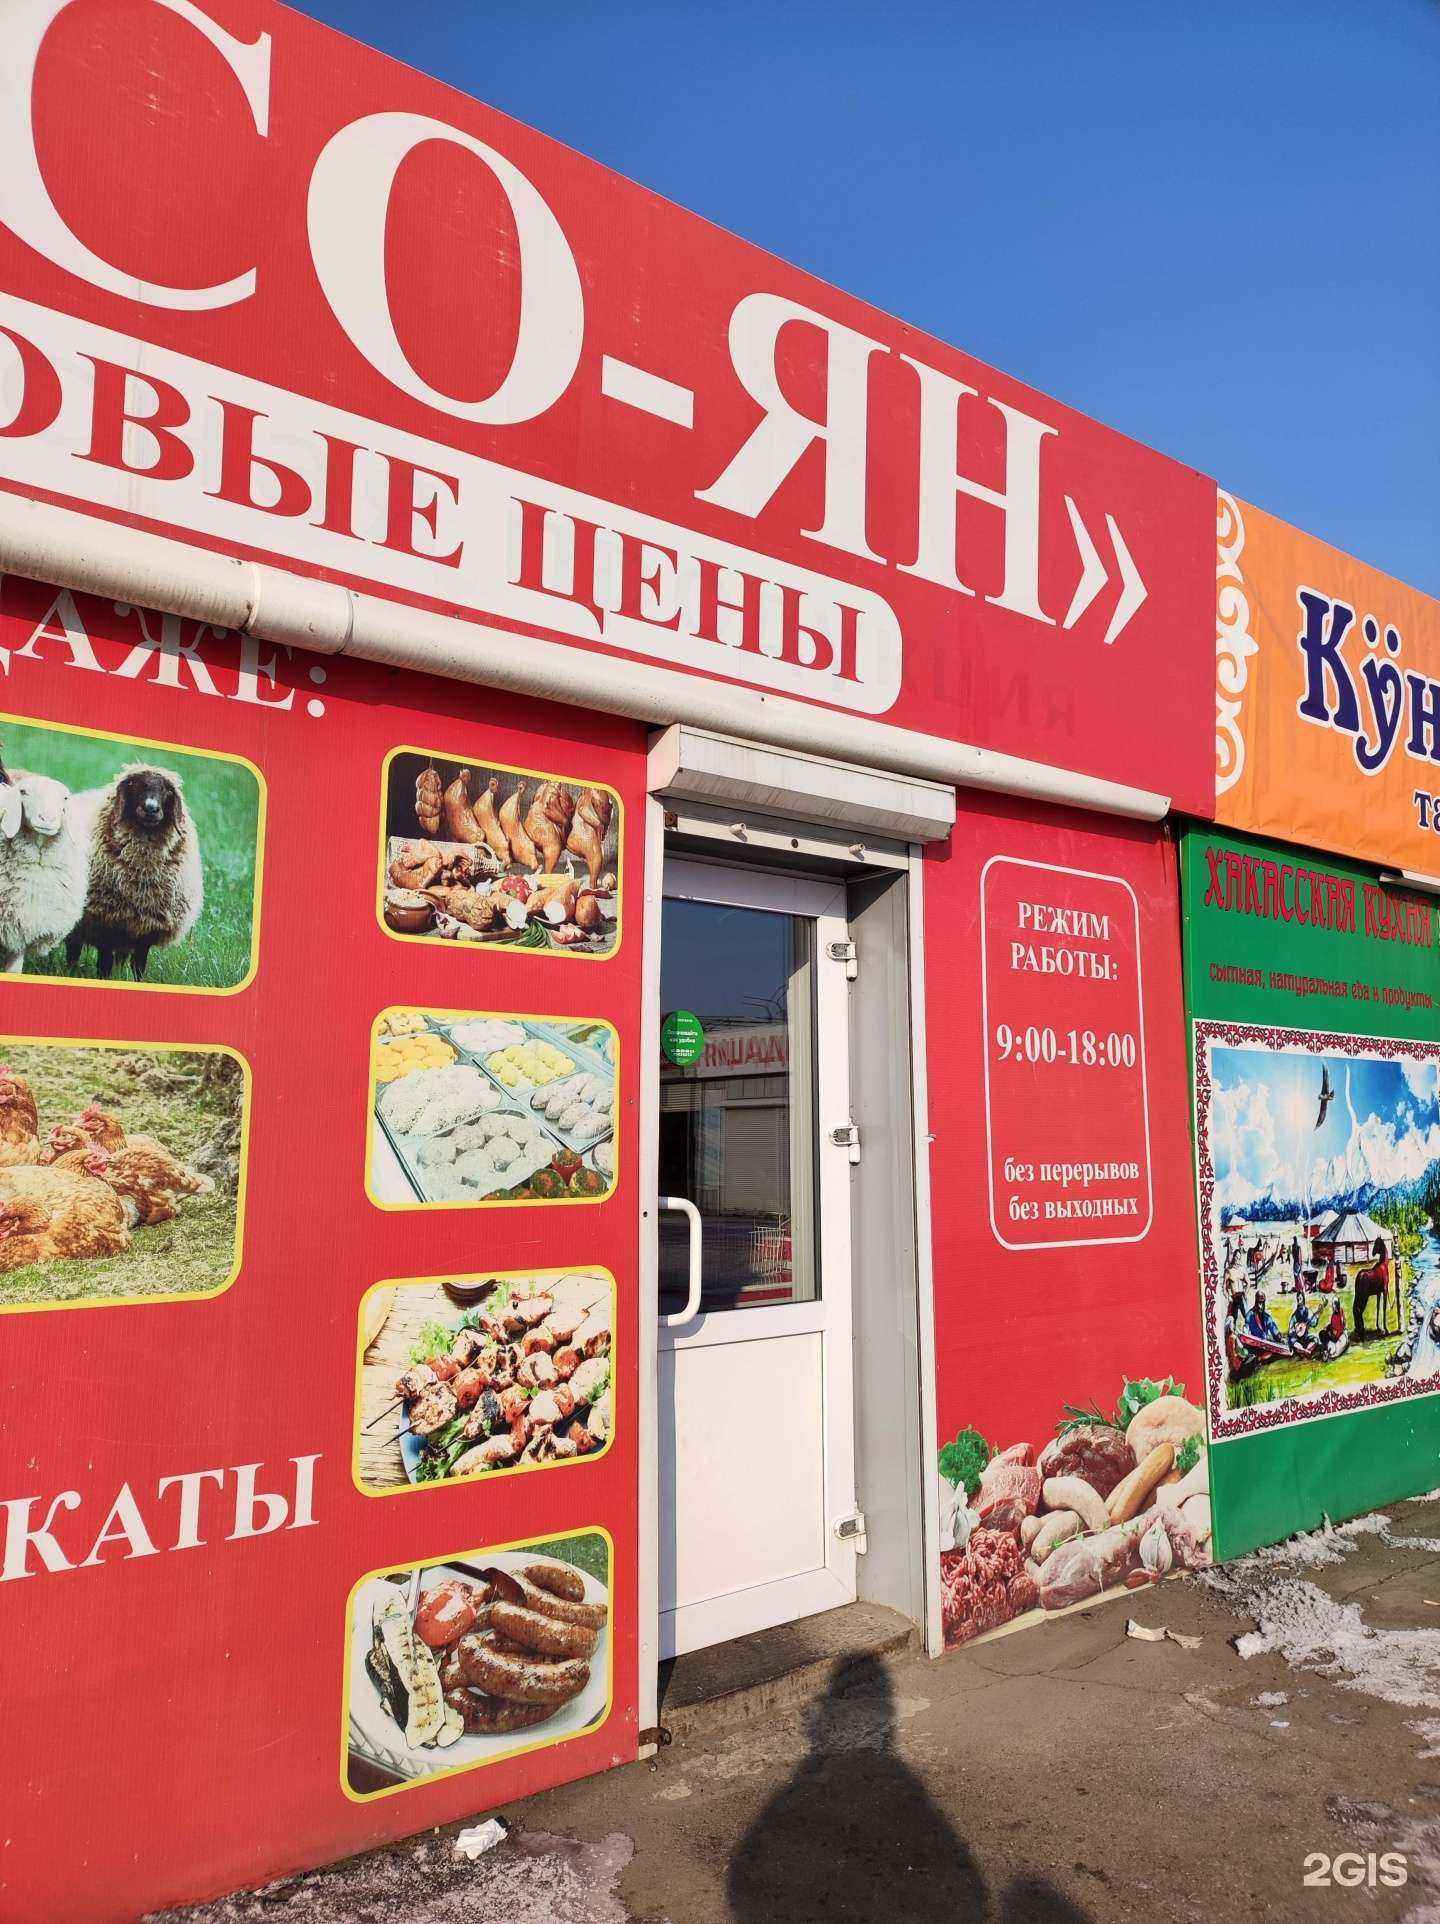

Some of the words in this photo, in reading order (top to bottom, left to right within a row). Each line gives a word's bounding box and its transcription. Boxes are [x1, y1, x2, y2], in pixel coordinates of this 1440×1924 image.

[507, 496, 866, 684] ЦЕНЫ
[0, 588, 326, 718] АЖЕ:
[1204, 847, 1357, 934] ХАКАССКАЯ
[1017, 901, 1111, 941] РЕЖИМ
[1010, 942, 1119, 981] РАБОТЫ:
[996, 1023, 1136, 1068] 9:00-18:00
[1004, 1157, 1035, 1182] без
[1039, 1162, 1140, 1188] перерывов
[1009, 1195, 1039, 1221] без
[1044, 1197, 1139, 1221] выходных
[0, 1453, 323, 1583] КАТЫ
